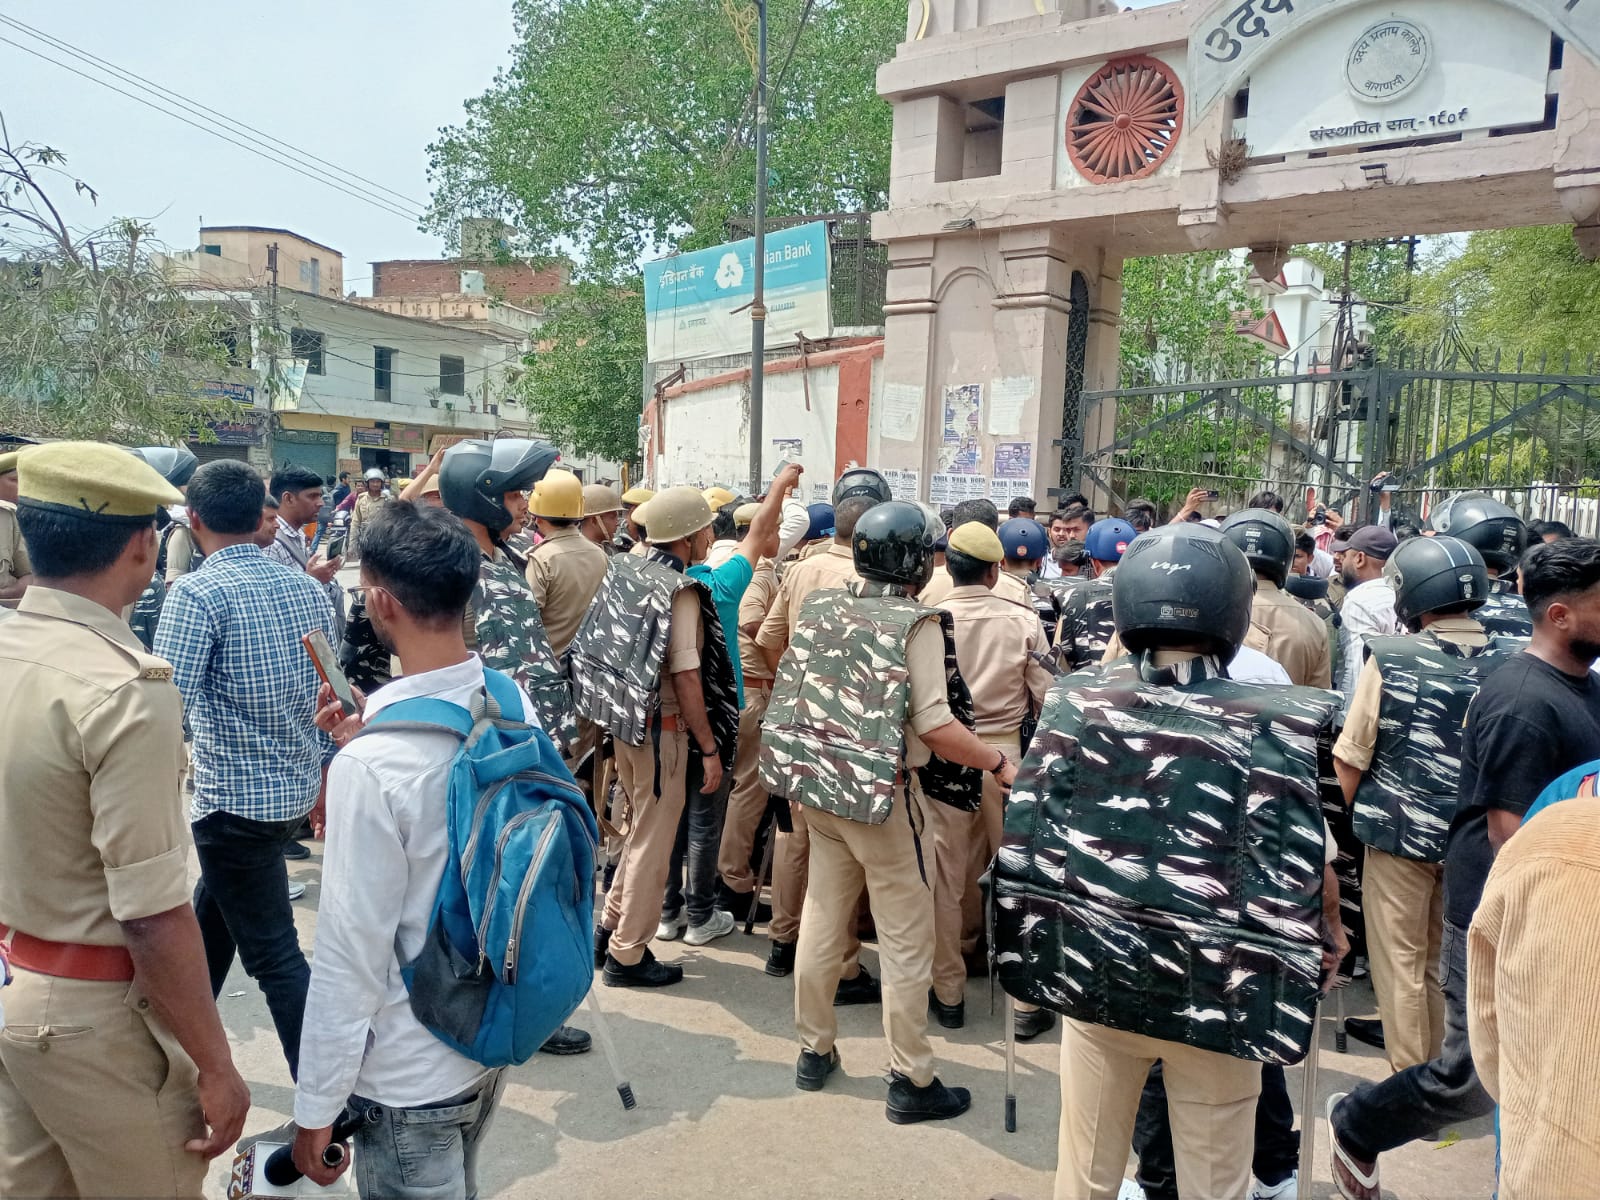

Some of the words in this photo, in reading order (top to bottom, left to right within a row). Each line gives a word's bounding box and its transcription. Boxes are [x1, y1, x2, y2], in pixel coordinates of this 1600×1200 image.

[1370, 27, 1400, 42] प्रताप
[1365, 74, 1405, 92] वाराणसी
[1310, 121, 1381, 141] संस्थापित
[750, 249, 782, 268] Iian
[783, 240, 812, 260] Bank
